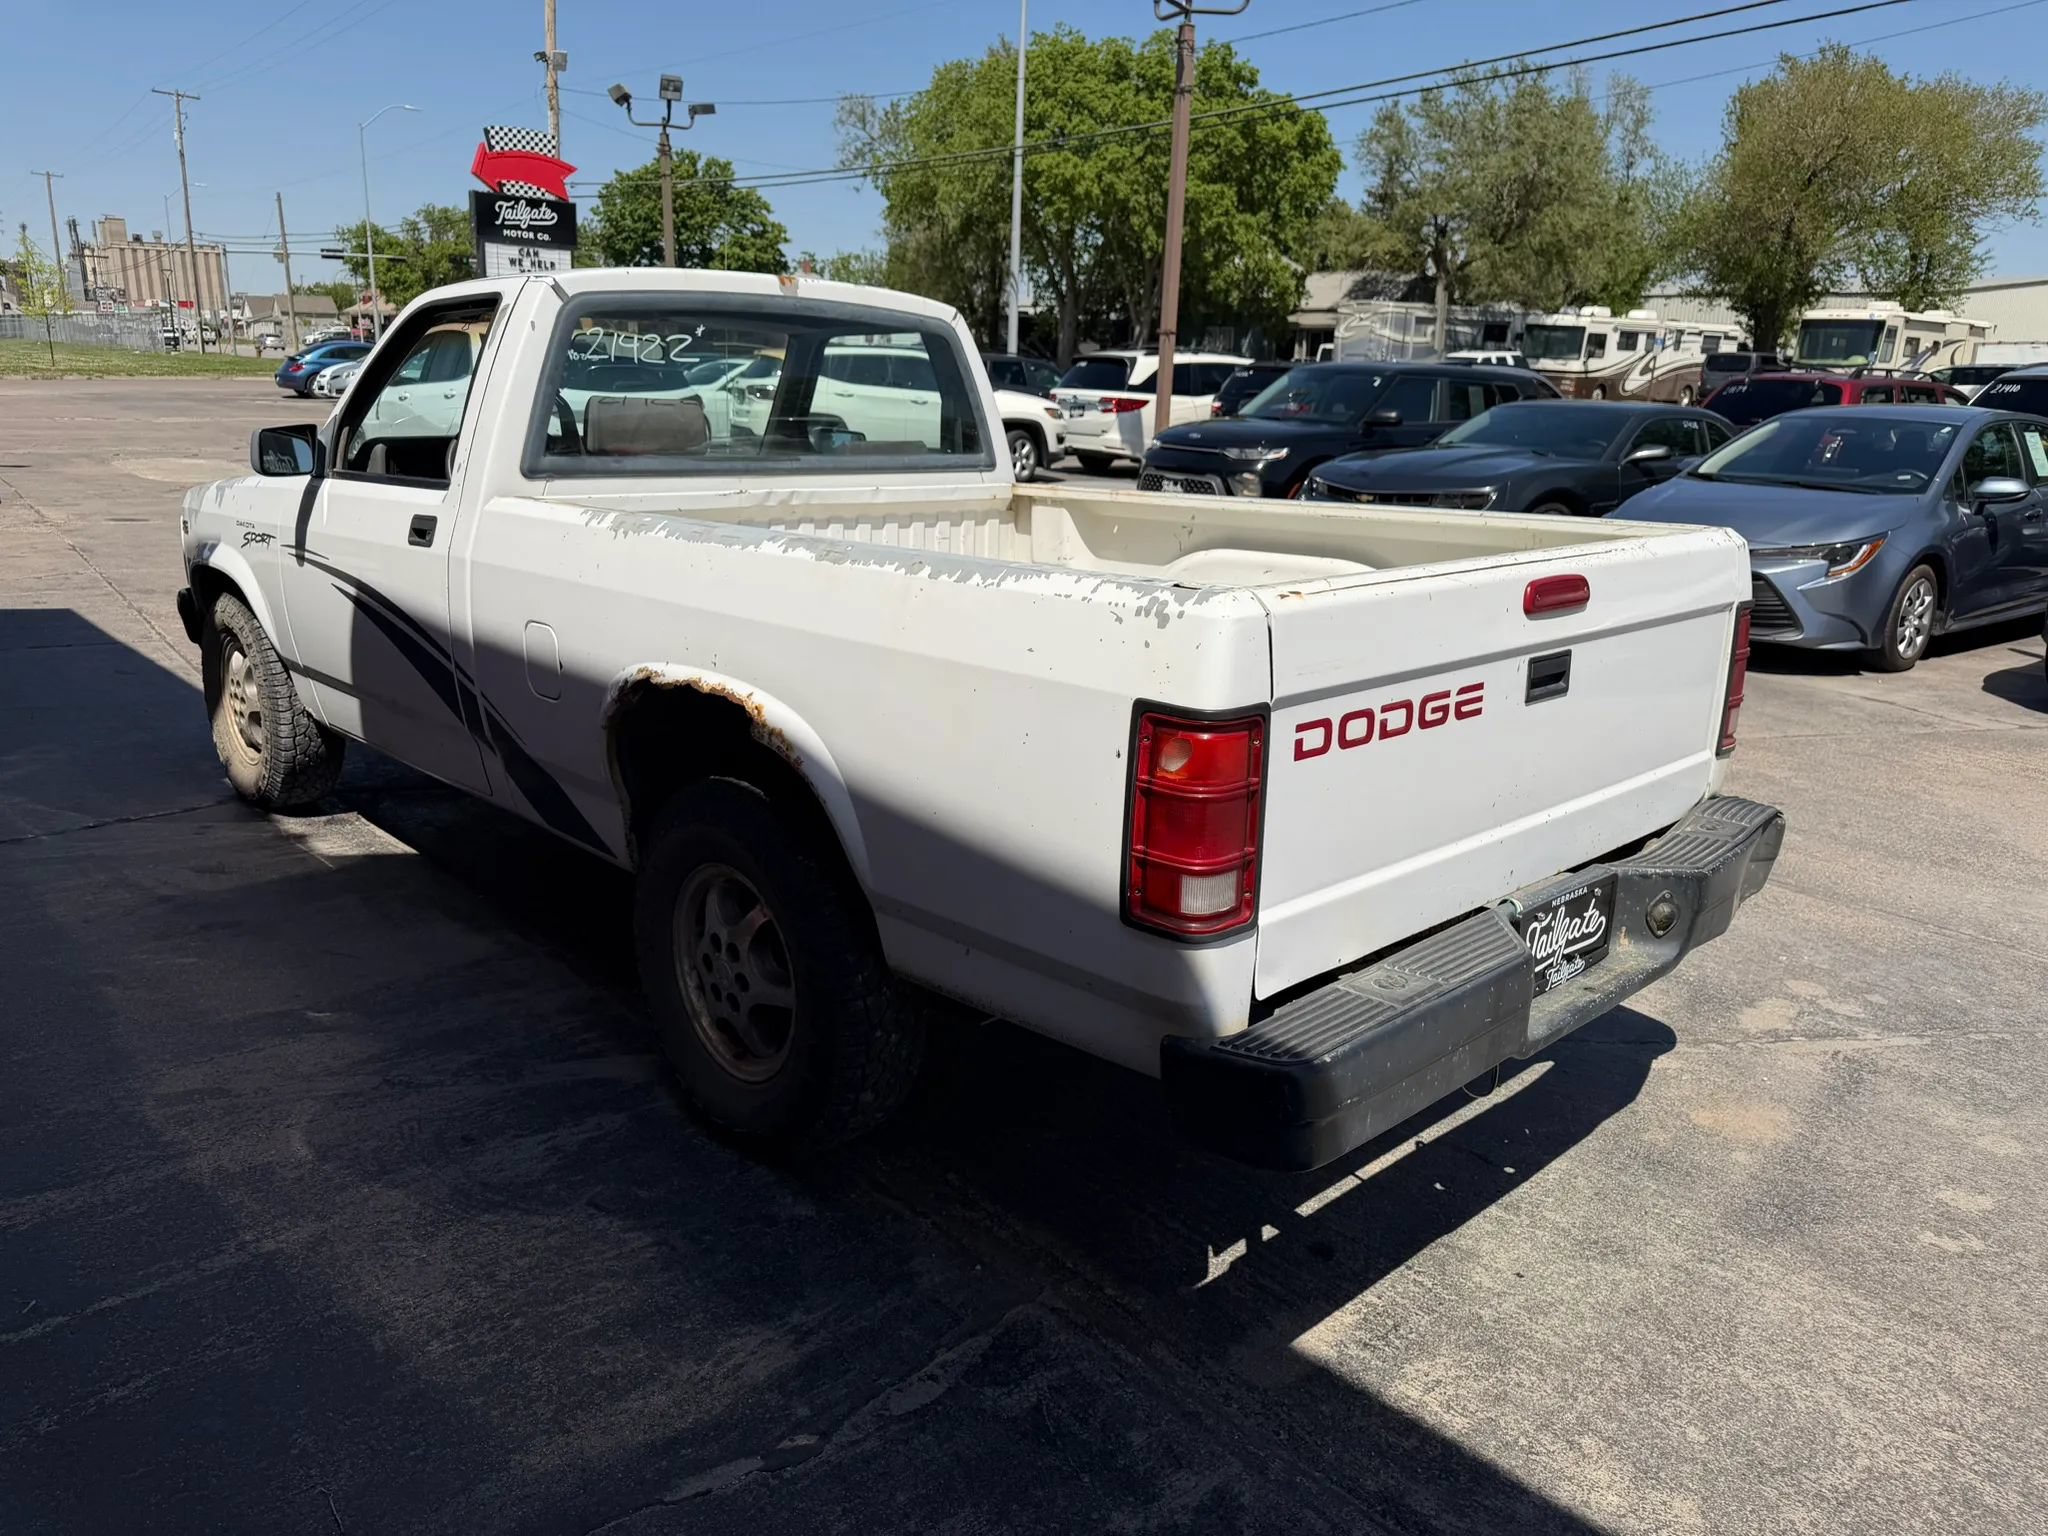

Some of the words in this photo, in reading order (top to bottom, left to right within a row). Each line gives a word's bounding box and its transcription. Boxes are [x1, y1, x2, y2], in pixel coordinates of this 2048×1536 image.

[495, 200, 558, 229] Tailgate
[503, 229, 535, 240] MOTOR
[537, 232, 551, 241] CO.
[508, 257, 524, 268] WE
[530, 258, 556, 271] HELP
[518, 247, 539, 258] CAN
[586, 327, 701, 364] 21422
[241, 531, 277, 551] SPORT
[1293, 681, 1485, 762] DODGE
[1551, 886, 1588, 907] NEBRASKA
[1526, 898, 1606, 972] Tailgate
[1545, 954, 1586, 991] Tailgate
